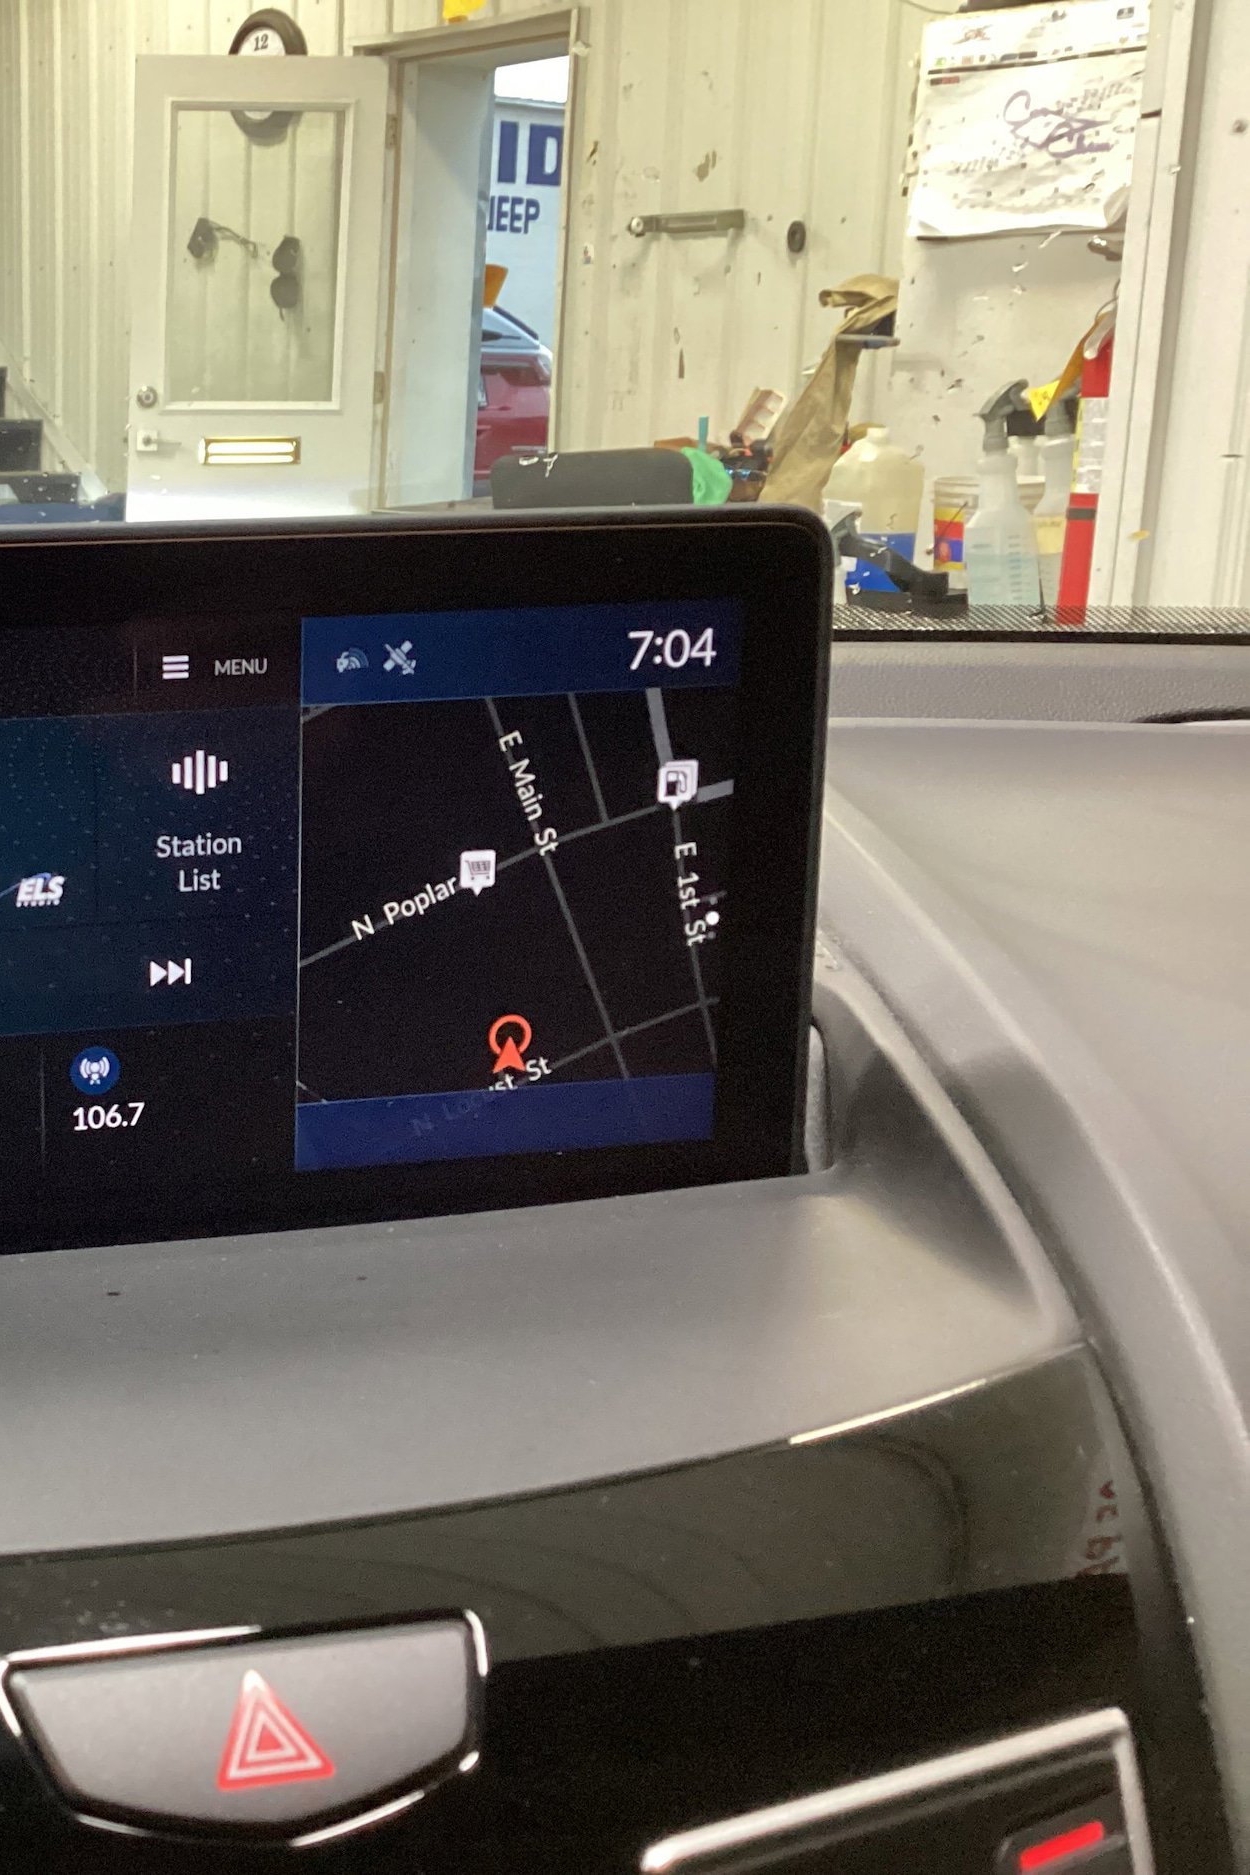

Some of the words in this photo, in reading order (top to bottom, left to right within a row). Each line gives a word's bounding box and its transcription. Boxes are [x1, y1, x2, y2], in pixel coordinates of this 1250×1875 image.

[253, 33, 269, 51] 12
[487, 195, 541, 234] JEEP
[627, 627, 717, 671] 7:04
[213, 658, 268, 677] MENU
[499, 730, 523, 752] E
[509, 758, 543, 820] Main
[155, 831, 243, 859] Station
[534, 827, 559, 857] St
[674, 842, 698, 859] E
[17, 875, 67, 900] ELS
[179, 867, 222, 892] List
[678, 872, 701, 910] 1st
[351, 914, 375, 941] N
[383, 876, 457, 925] Poplar
[685, 920, 707, 947] St
[526, 1056, 552, 1081] St
[71, 1100, 146, 1132] 106.7
